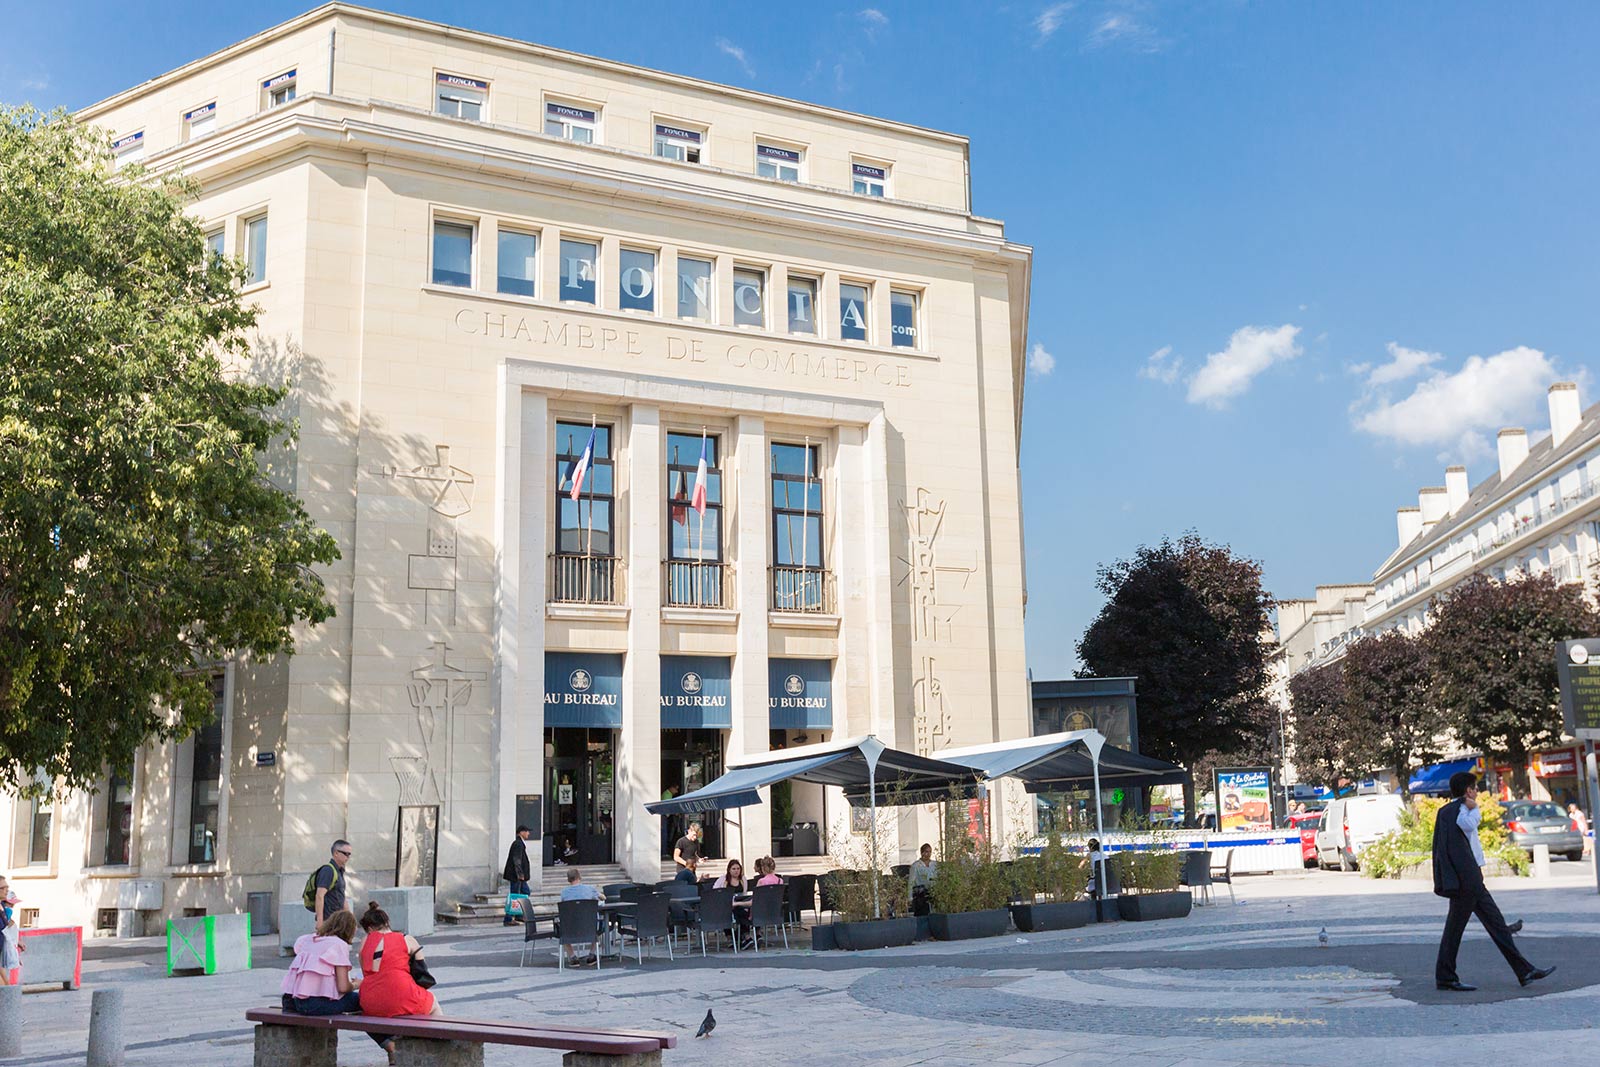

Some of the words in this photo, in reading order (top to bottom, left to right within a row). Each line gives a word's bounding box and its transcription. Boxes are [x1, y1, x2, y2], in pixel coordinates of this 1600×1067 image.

[447, 76, 477, 88] FONCIA
[556, 106, 584, 118] FONCIA
[663, 127, 689, 138] FONCIA
[765, 147, 790, 158] FONCIA
[856, 165, 879, 176] FONCIA
[455, 308, 644, 355] CHAMBRE
[666, 336, 707, 362] DE
[726, 344, 913, 388] COMMERCE
[543, 693, 561, 704] AU
[564, 693, 617, 706] BUREAU
[660, 695, 674, 707] AU
[677, 695, 727, 707] BUREAU
[768, 697, 778, 708] U
[781, 697, 827, 708] BUREAU
